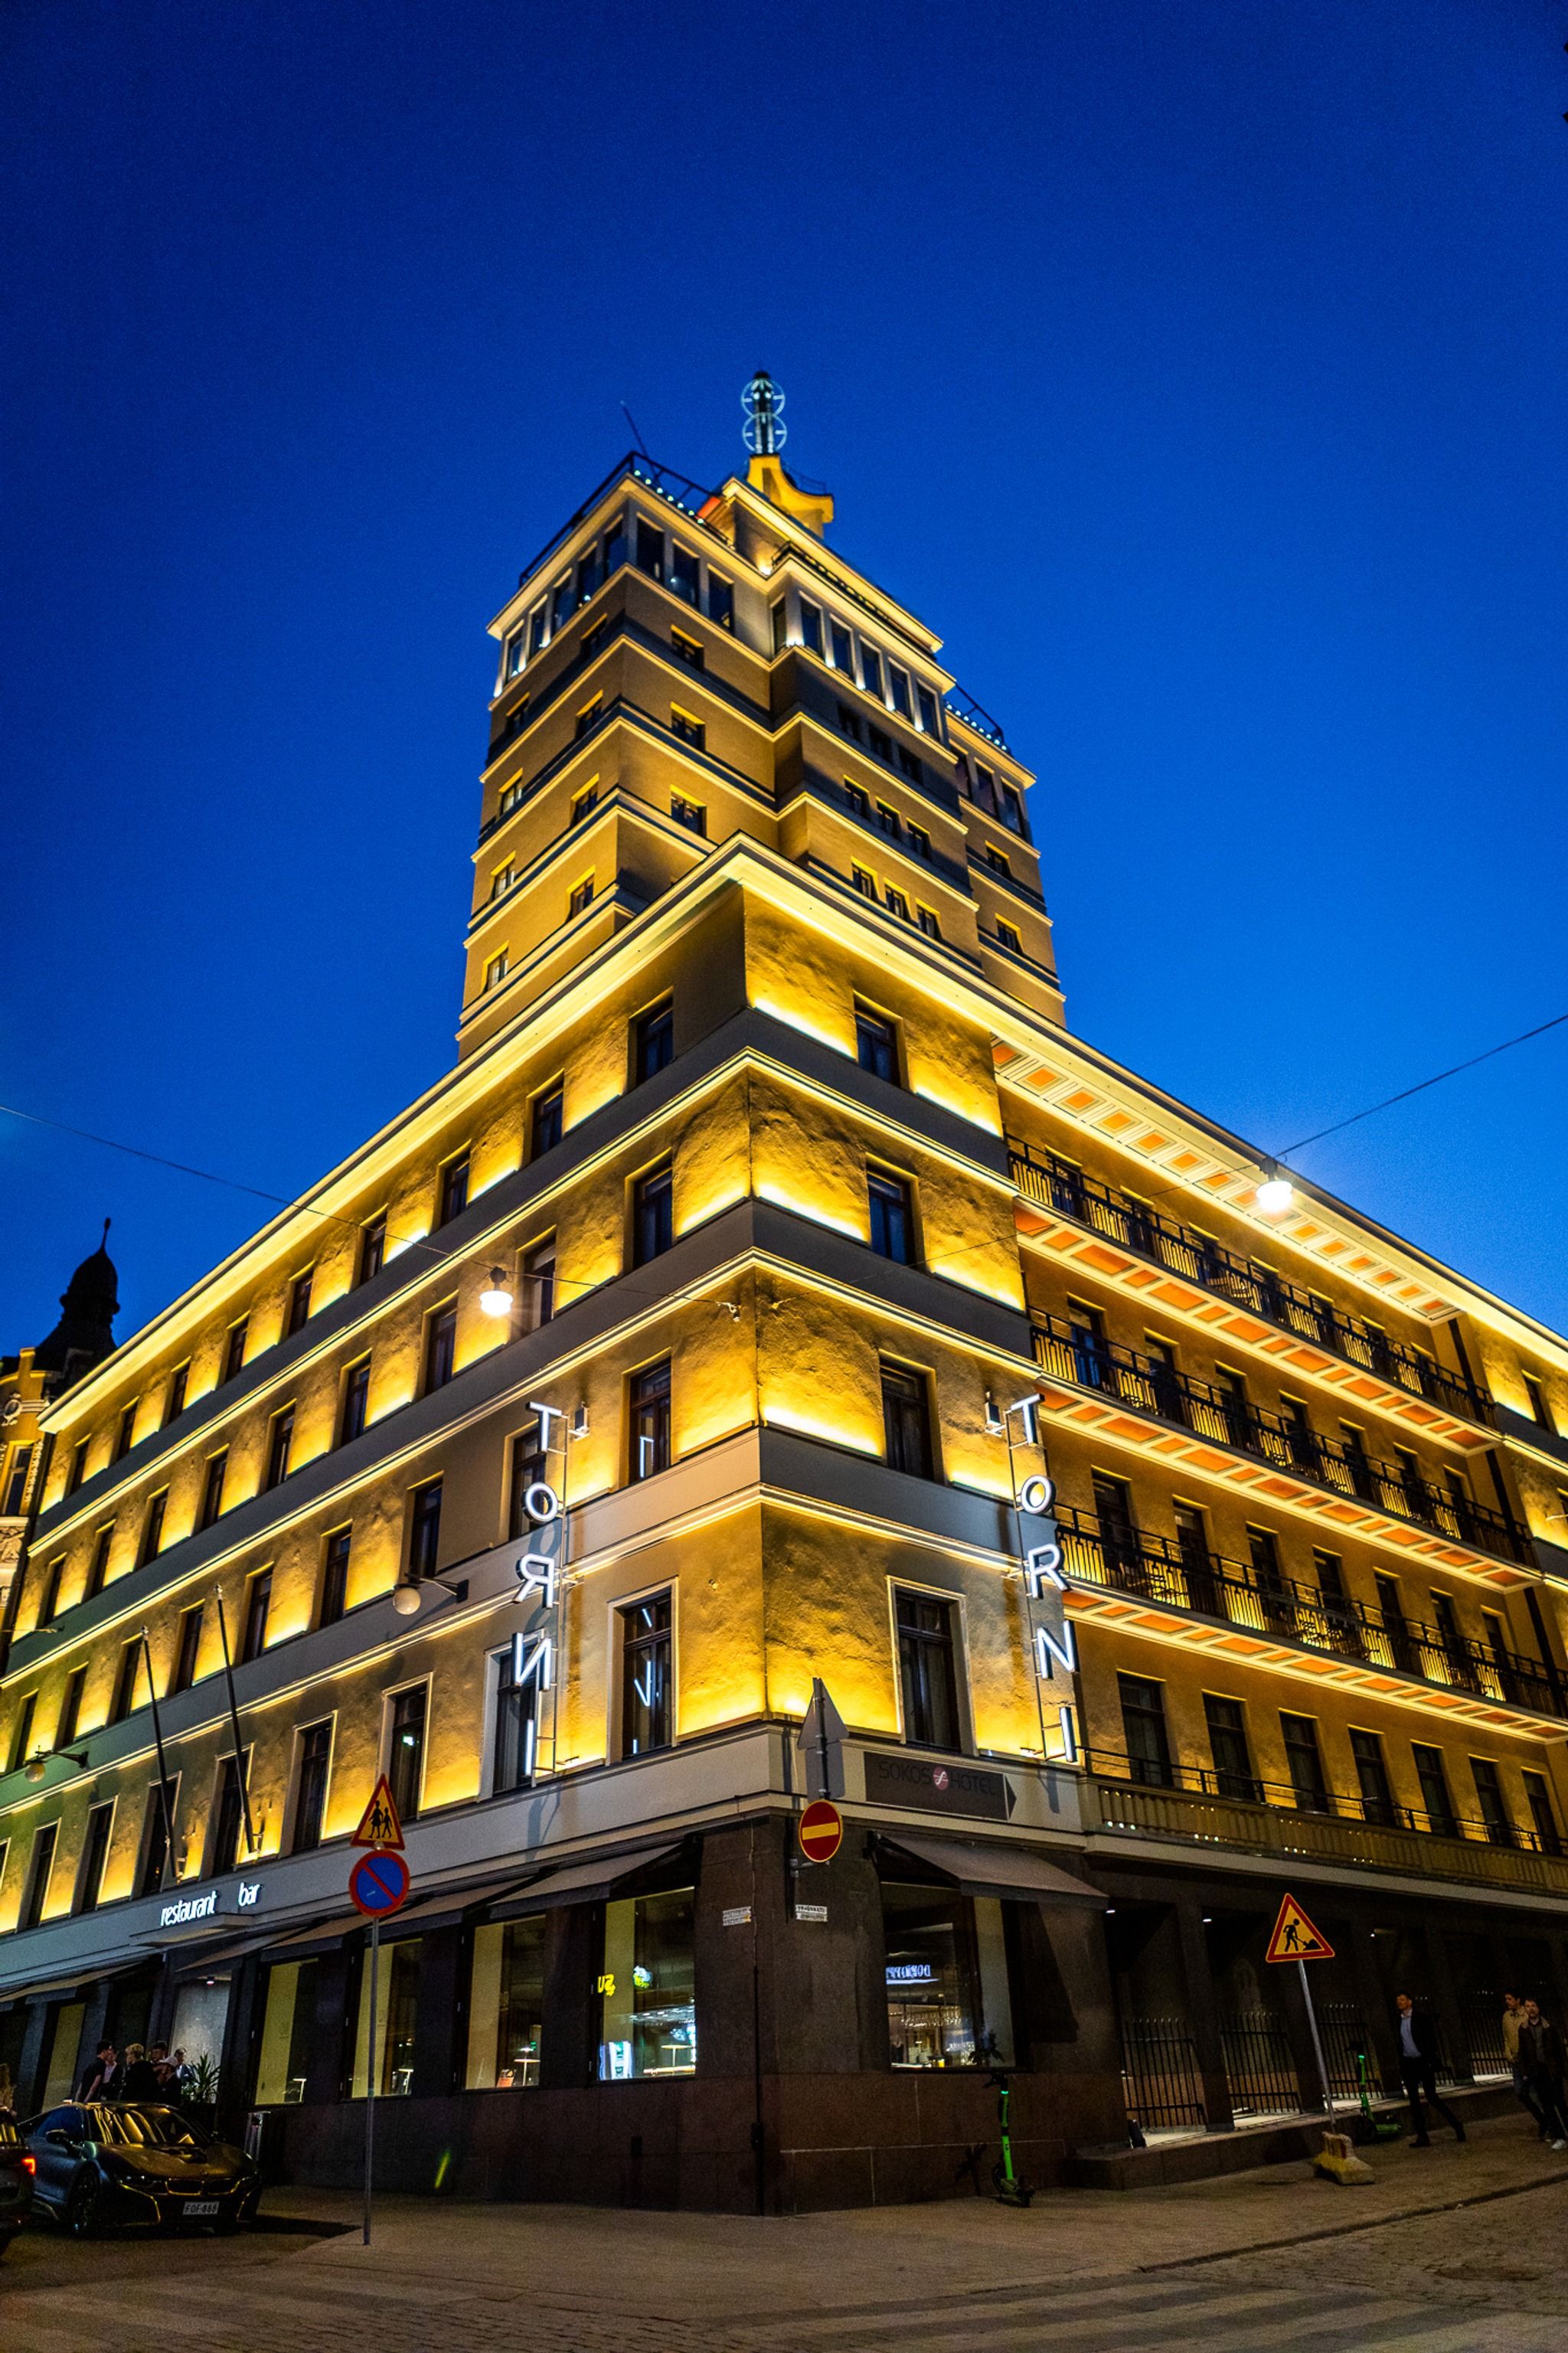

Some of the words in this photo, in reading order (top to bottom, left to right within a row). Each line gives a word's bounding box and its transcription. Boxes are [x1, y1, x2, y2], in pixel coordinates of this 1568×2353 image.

[1010, 1393, 1080, 1763] TORNI
[878, 1761, 932, 1786] SOKOS
[949, 1772, 995, 1796] HOTEL
[160, 1890, 217, 1927] restaurant
[238, 1882, 262, 1907] bar
